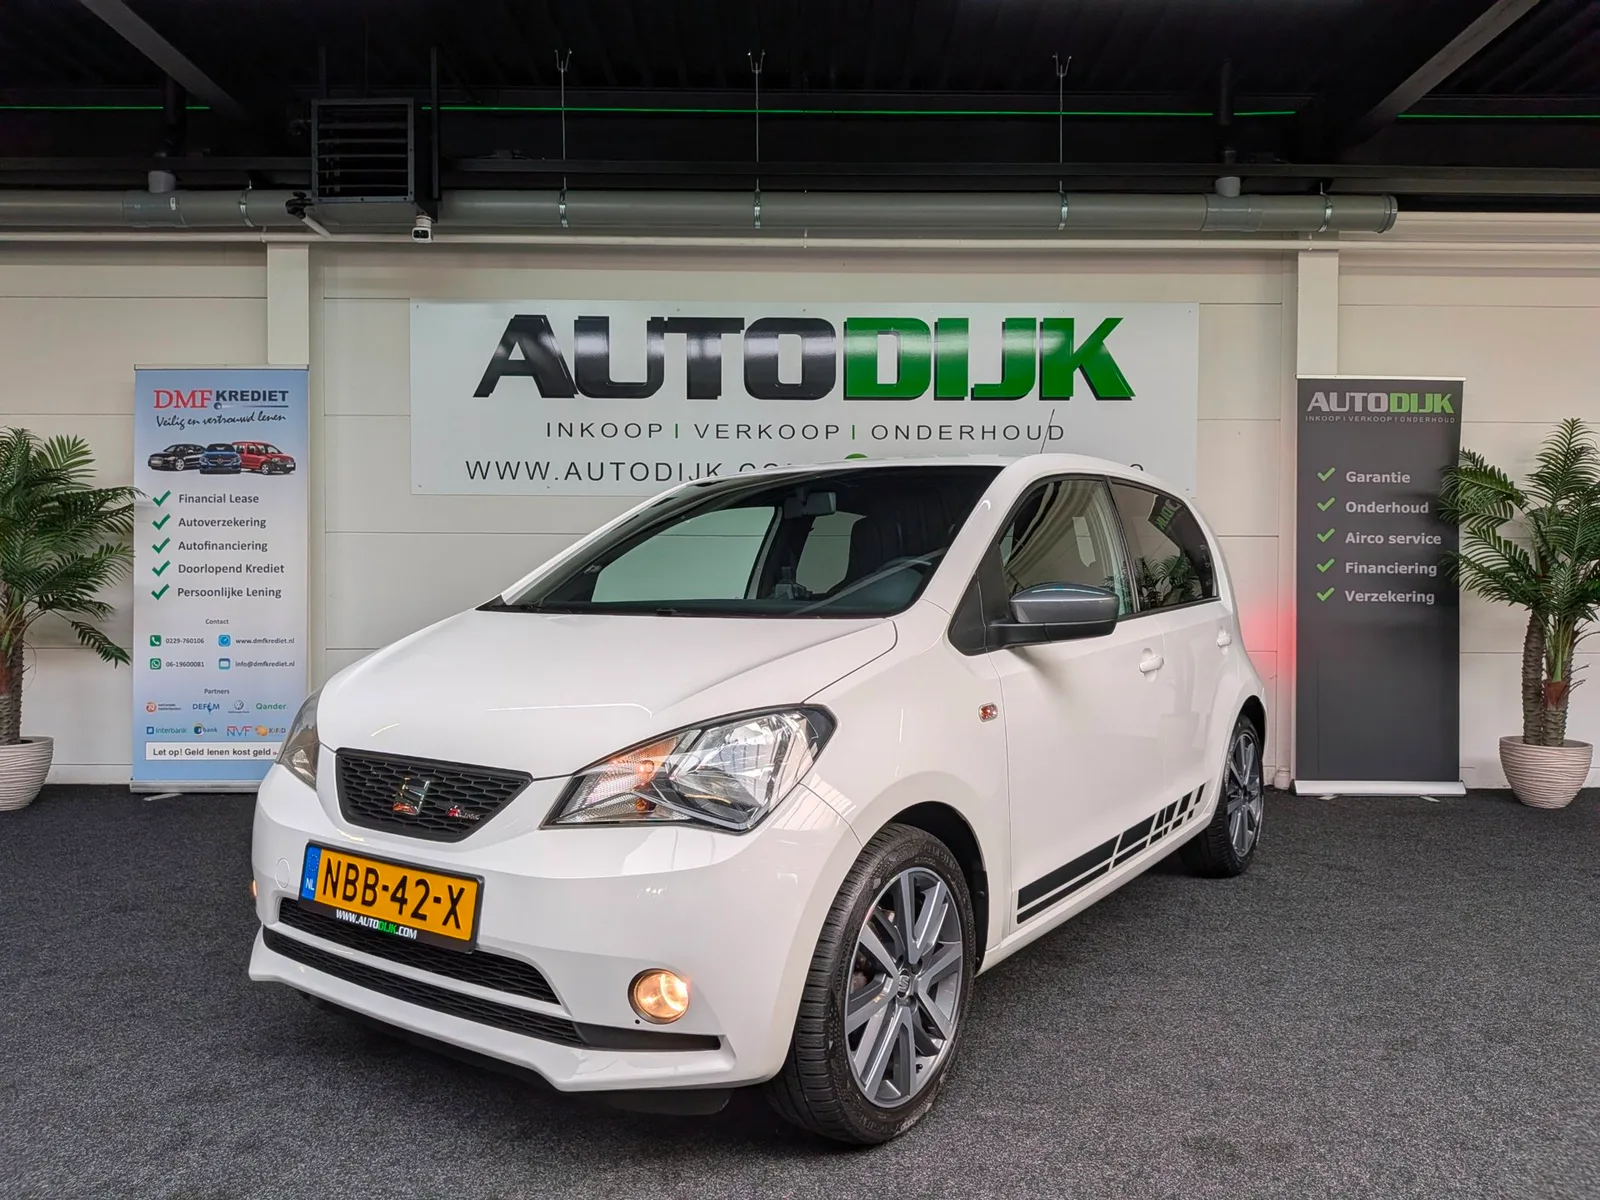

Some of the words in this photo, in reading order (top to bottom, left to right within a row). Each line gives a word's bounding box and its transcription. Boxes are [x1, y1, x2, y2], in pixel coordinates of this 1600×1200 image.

[473, 314, 1136, 401] AUTODIJK
[153, 389, 212, 409] DMF
[215, 390, 289, 402] KREDIET
[1307, 391, 1455, 414] AUTODIJK
[156, 414, 185, 431] Veilig
[203, 413, 255, 426] vertrouwd
[257, 410, 286, 422] lenen
[1400, 416, 1455, 424] ONDERHOUD
[546, 422, 663, 438] INKOOP
[694, 423, 840, 440] VERKOOP
[871, 424, 1065, 441] ONDERHOUD
[1345, 471, 1411, 483] Garantie
[178, 493, 226, 504] Financial
[229, 494, 260, 504] Lease
[1345, 501, 1429, 514] Onderhoud
[178, 517, 267, 529] Autoverzekering
[1345, 532, 1384, 544] Airco
[1388, 532, 1442, 545] service
[178, 540, 268, 553] Autofinanciering
[178, 563, 243, 576] Doorlopend
[245, 563, 285, 574] Krediet
[1345, 562, 1438, 577] Financiering
[177, 587, 244, 599] Persoonlijke
[246, 587, 282, 599] Lening
[1345, 590, 1435, 605] Verzekering
[235, 637, 295, 645] www.dmfkrediet.nl
[235, 660, 295, 669] info@dmfkrediet.nl
[153, 748, 167, 756] Let
[168, 748, 183, 758] op!
[184, 748, 204, 756] Geld
[207, 748, 230, 756] lenen
[232, 748, 251, 756] kost
[253, 748, 271, 758] geld
[305, 877, 315, 891] NL
[322, 857, 465, 930] NBB-42-X
[335, 908, 418, 940] WWW.AUTODIJK.COM
